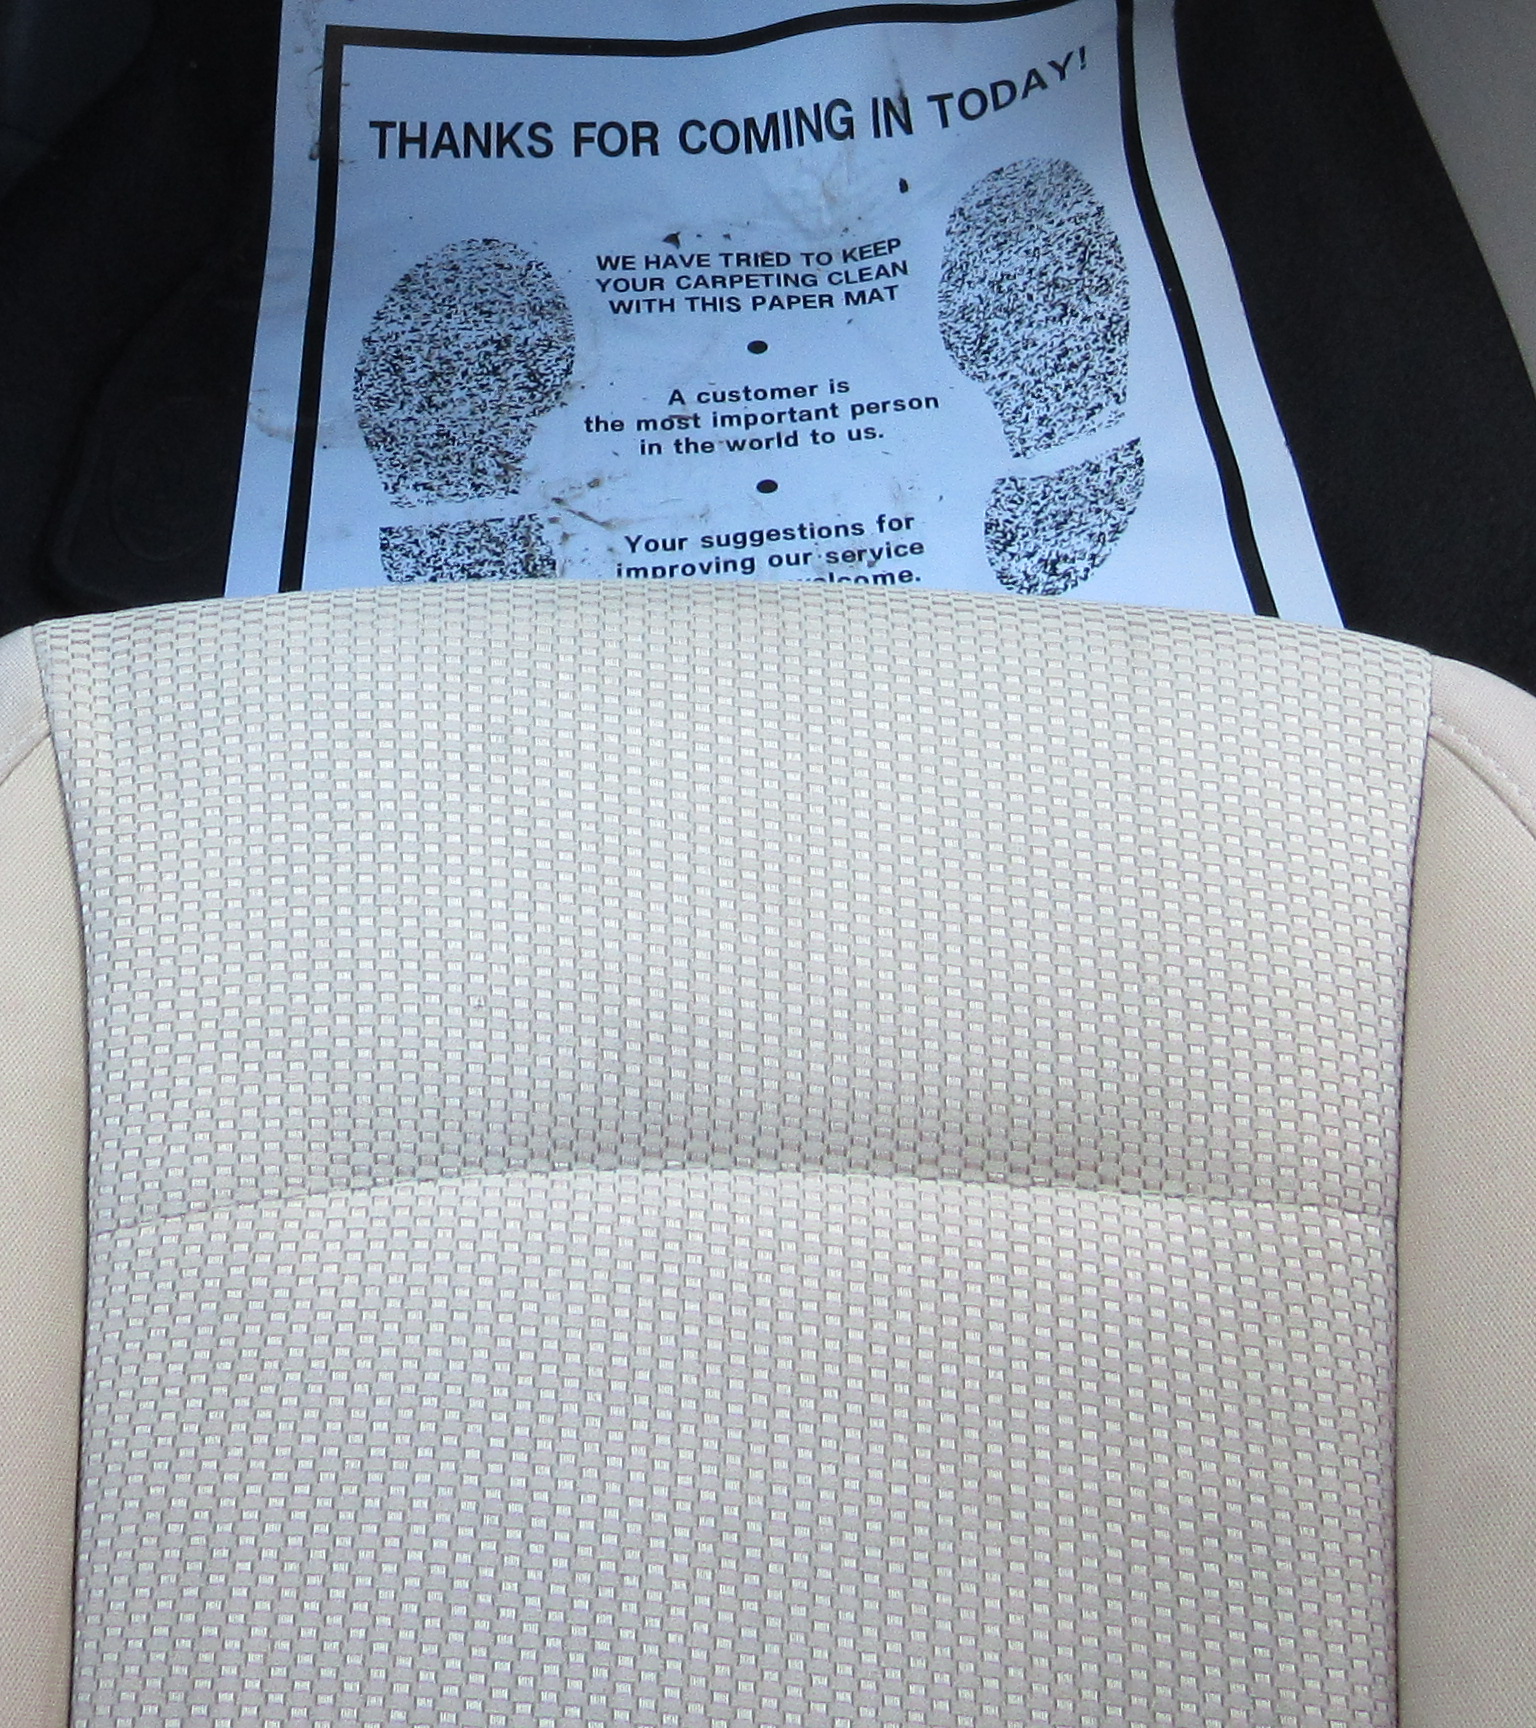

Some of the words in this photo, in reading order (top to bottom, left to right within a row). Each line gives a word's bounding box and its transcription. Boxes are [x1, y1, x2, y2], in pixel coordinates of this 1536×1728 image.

[368, 120, 555, 159] THANKS
[573, 121, 660, 158] FOR
[678, 98, 855, 155] COMING
[871, 96, 913, 139] IN
[927, 45, 1086, 129] TODAY!
[595, 254, 636, 272] WE
[644, 252, 711, 270] HAVE
[718, 251, 791, 268] TRIED
[800, 250, 833, 268] TO
[841, 237, 902, 264] KEEP
[596, 276, 666, 293] YOUR
[675, 272, 818, 291] CARPETING
[827, 259, 909, 287] CLEAN
[609, 295, 675, 315] WITH
[685, 294, 743, 313] THIS
[752, 292, 834, 312] PAPER
[844, 283, 900, 307] MAT
[668, 388, 686, 406] A
[696, 383, 819, 405] customer
[829, 378, 850, 395] is
[584, 416, 624, 433] the
[636, 413, 702, 432] most
[712, 402, 840, 431] important
[850, 395, 940, 421] person
[639, 439, 662, 456] in
[673, 437, 715, 454] the
[726, 430, 799, 453] world
[810, 427, 836, 446] to
[847, 424, 885, 442] us.
[624, 534, 689, 554] Your
[700, 520, 865, 551] suggestions
[875, 513, 915, 534] for
[616, 555, 756, 580] improving
[767, 550, 813, 568] our
[825, 541, 925, 565] service
